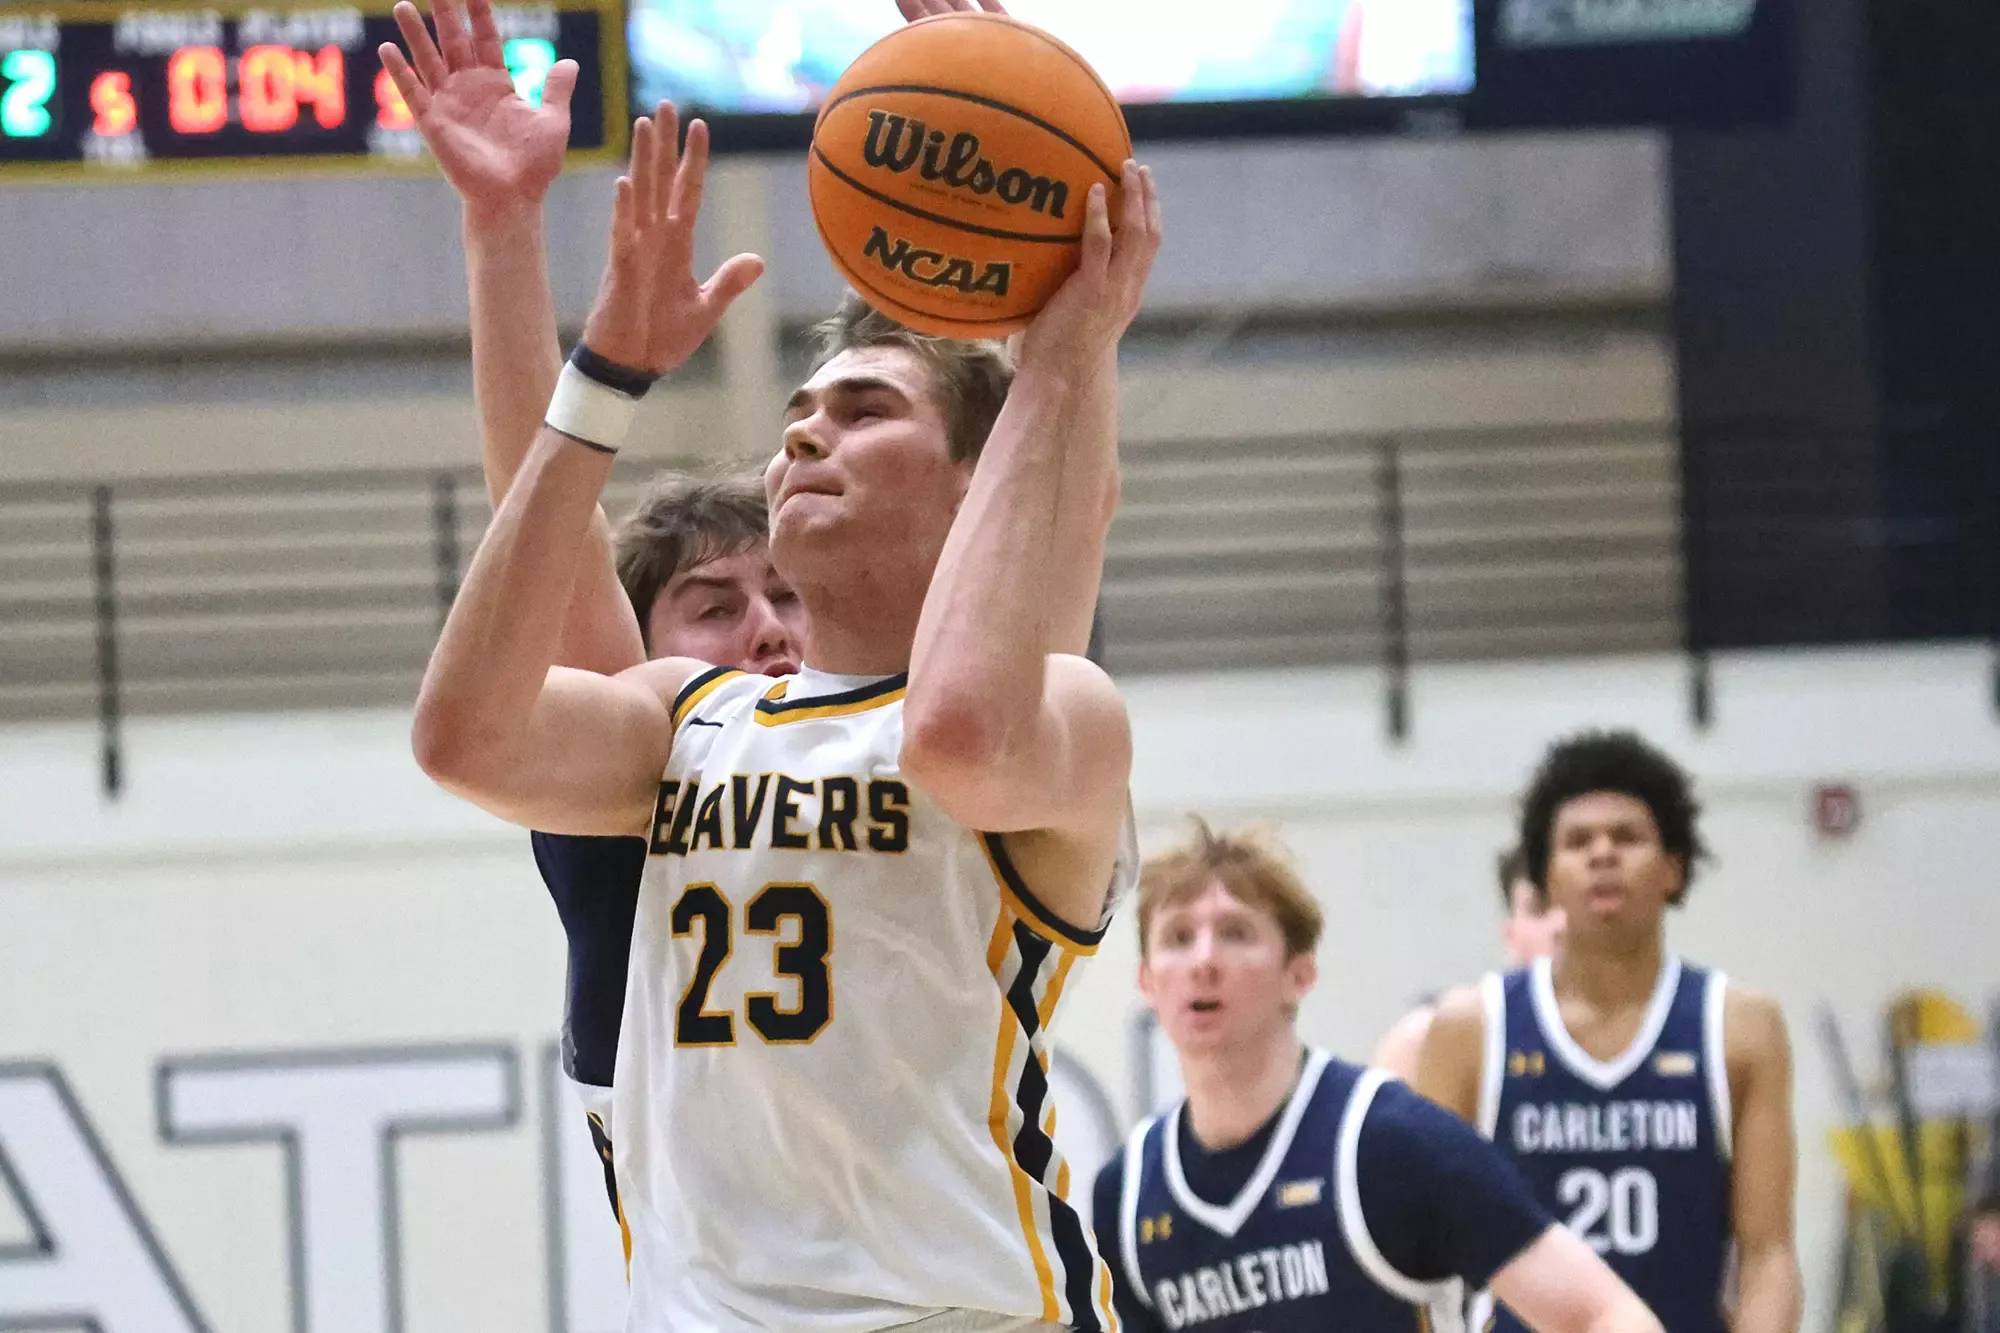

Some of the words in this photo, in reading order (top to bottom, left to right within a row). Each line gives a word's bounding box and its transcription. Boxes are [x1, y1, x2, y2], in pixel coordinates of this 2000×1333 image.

[862, 108, 1069, 219] Wilson
[863, 225, 1013, 297] NCAA
[670, 881, 835, 1049] 23
[1512, 1100, 1698, 1154] CARLETON
[1555, 1164, 1659, 1256] 20
[1155, 1238, 1329, 1330] CARLETON
